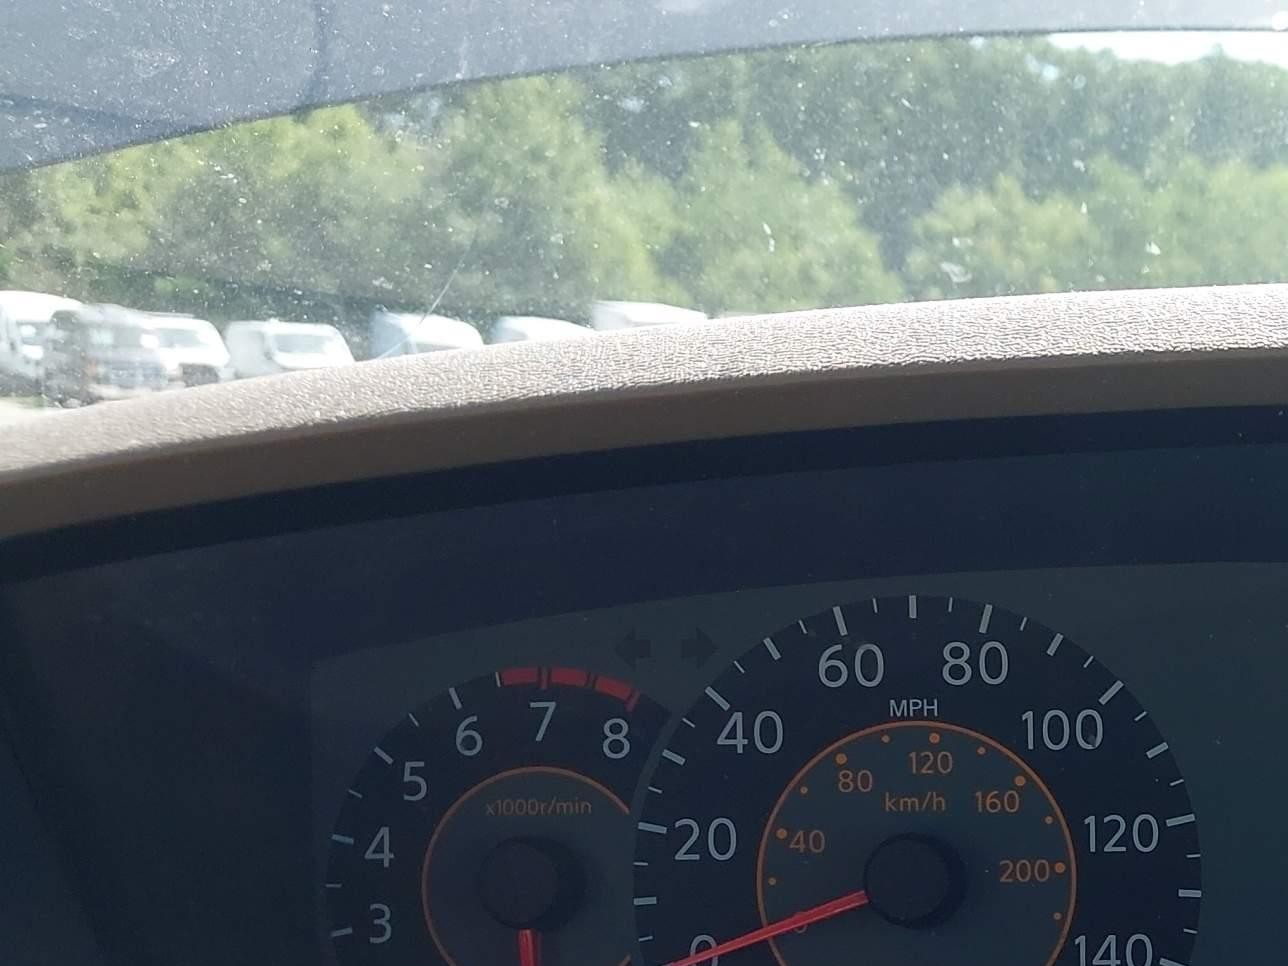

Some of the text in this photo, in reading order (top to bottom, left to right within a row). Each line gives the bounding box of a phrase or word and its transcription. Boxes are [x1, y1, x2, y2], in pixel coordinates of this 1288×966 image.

[817, 643, 886, 688] 60
[941, 641, 1010, 686] 80
[529, 700, 557, 741] 7
[888, 698, 940, 718] MPH
[454, 715, 484, 757] 6
[602, 718, 631, 759] 8
[716, 710, 784, 755] 40
[1022, 708, 1104, 751] 100
[402, 760, 429, 802] 5
[837, 769, 874, 794] 80
[907, 750, 954, 775] 120
[884, 791, 946, 813] km/h
[974, 790, 1021, 815] 160
[363, 826, 396, 868] 4
[673, 817, 737, 861] 20
[788, 829, 826, 854] 40
[1083, 814, 1159, 853] 120
[999, 858, 1051, 883] 200
[368, 903, 393, 945] 3
